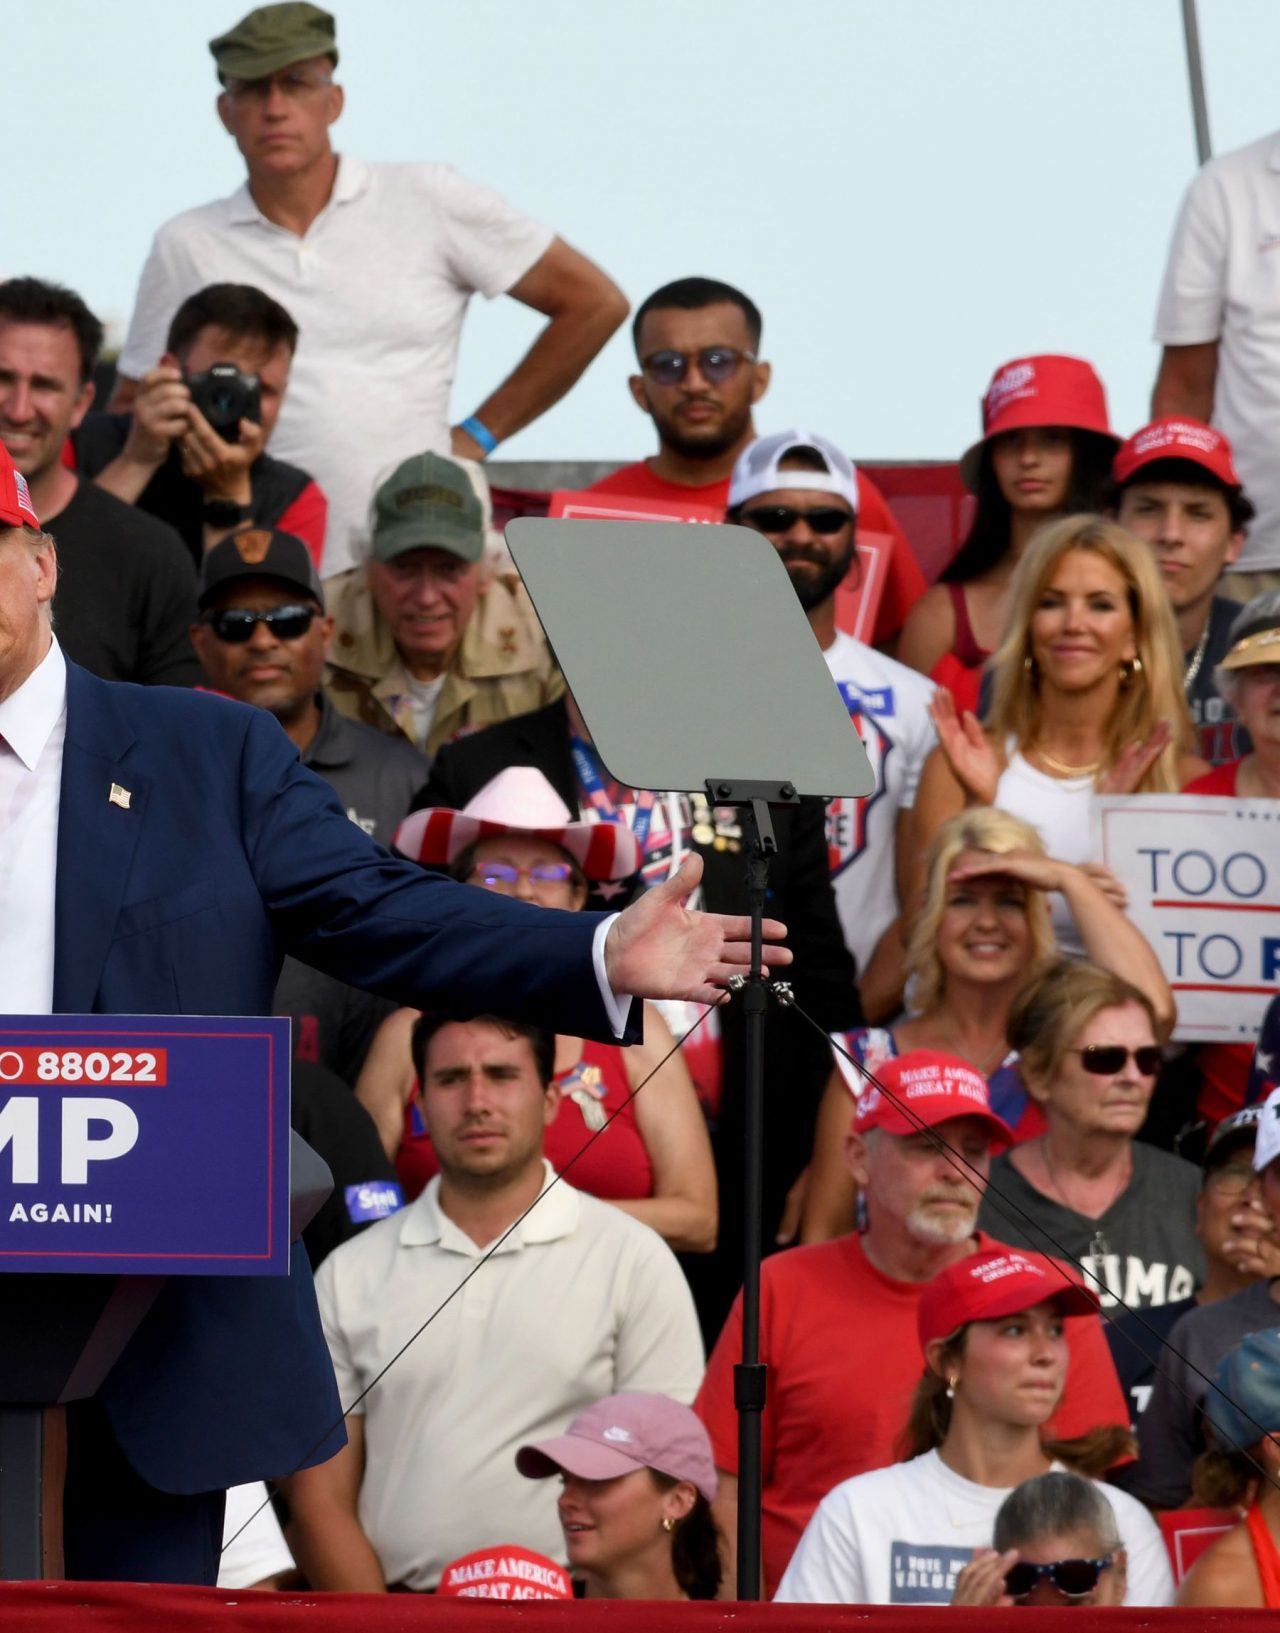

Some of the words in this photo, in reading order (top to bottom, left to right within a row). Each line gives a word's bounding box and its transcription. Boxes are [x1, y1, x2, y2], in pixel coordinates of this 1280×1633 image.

[1137, 848, 1267, 899] TOO
[1163, 931, 1243, 980] TO
[36, 1051, 157, 1081] 88022
[9, 1203, 113, 1223] AGAIN!
[448, 1558, 496, 1587] MAKE
[496, 1557, 567, 1596] AMERICA
[894, 1570, 957, 1590] VALUE
